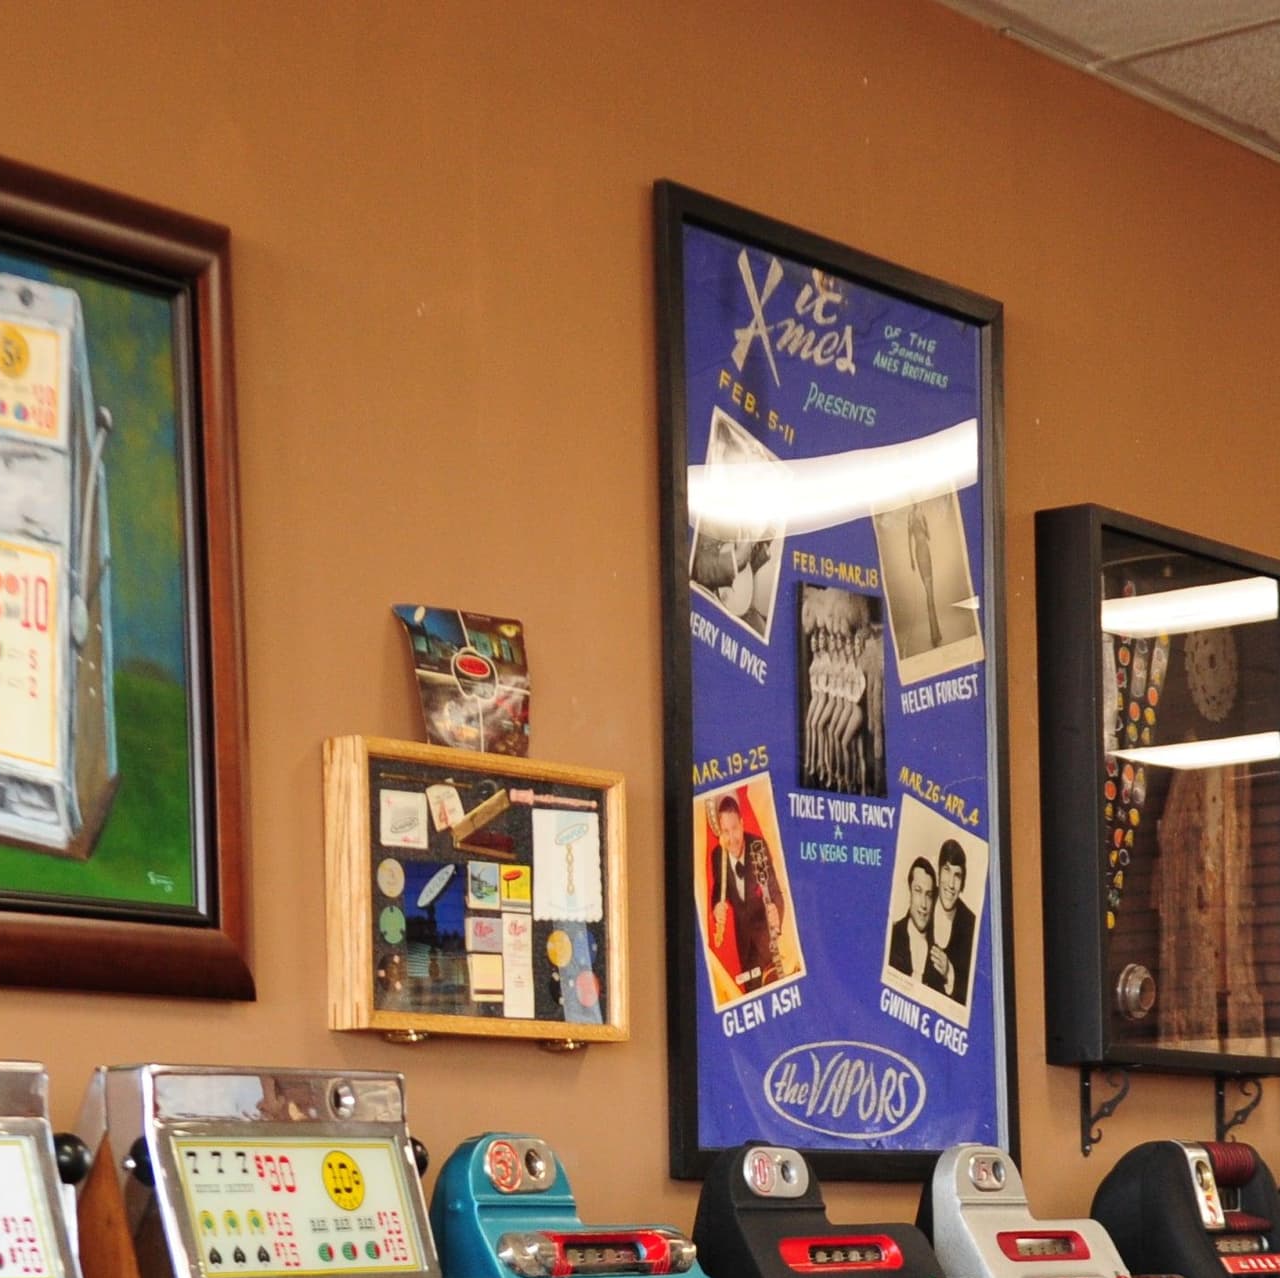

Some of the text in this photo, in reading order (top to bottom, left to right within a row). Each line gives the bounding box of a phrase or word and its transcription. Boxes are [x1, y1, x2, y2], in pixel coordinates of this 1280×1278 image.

[909, 333, 937, 352] THE
[872, 352, 950, 388] AMES BROTHERS
[802, 381, 877, 426] PRESENTS
[21, 576, 49, 632] 10
[720, 634, 738, 664] VAN
[739, 646, 768, 685] DYKE
[901, 674, 979, 715] HELEN FORREST
[787, 793, 896, 830] TICKLE YOUR FANCY
[834, 826, 843, 840] A
[800, 842, 882, 867] LAS VEGAS REVUE
[722, 985, 803, 1039] GLEN ASH
[879, 988, 969, 1057] GWINN & GREG
